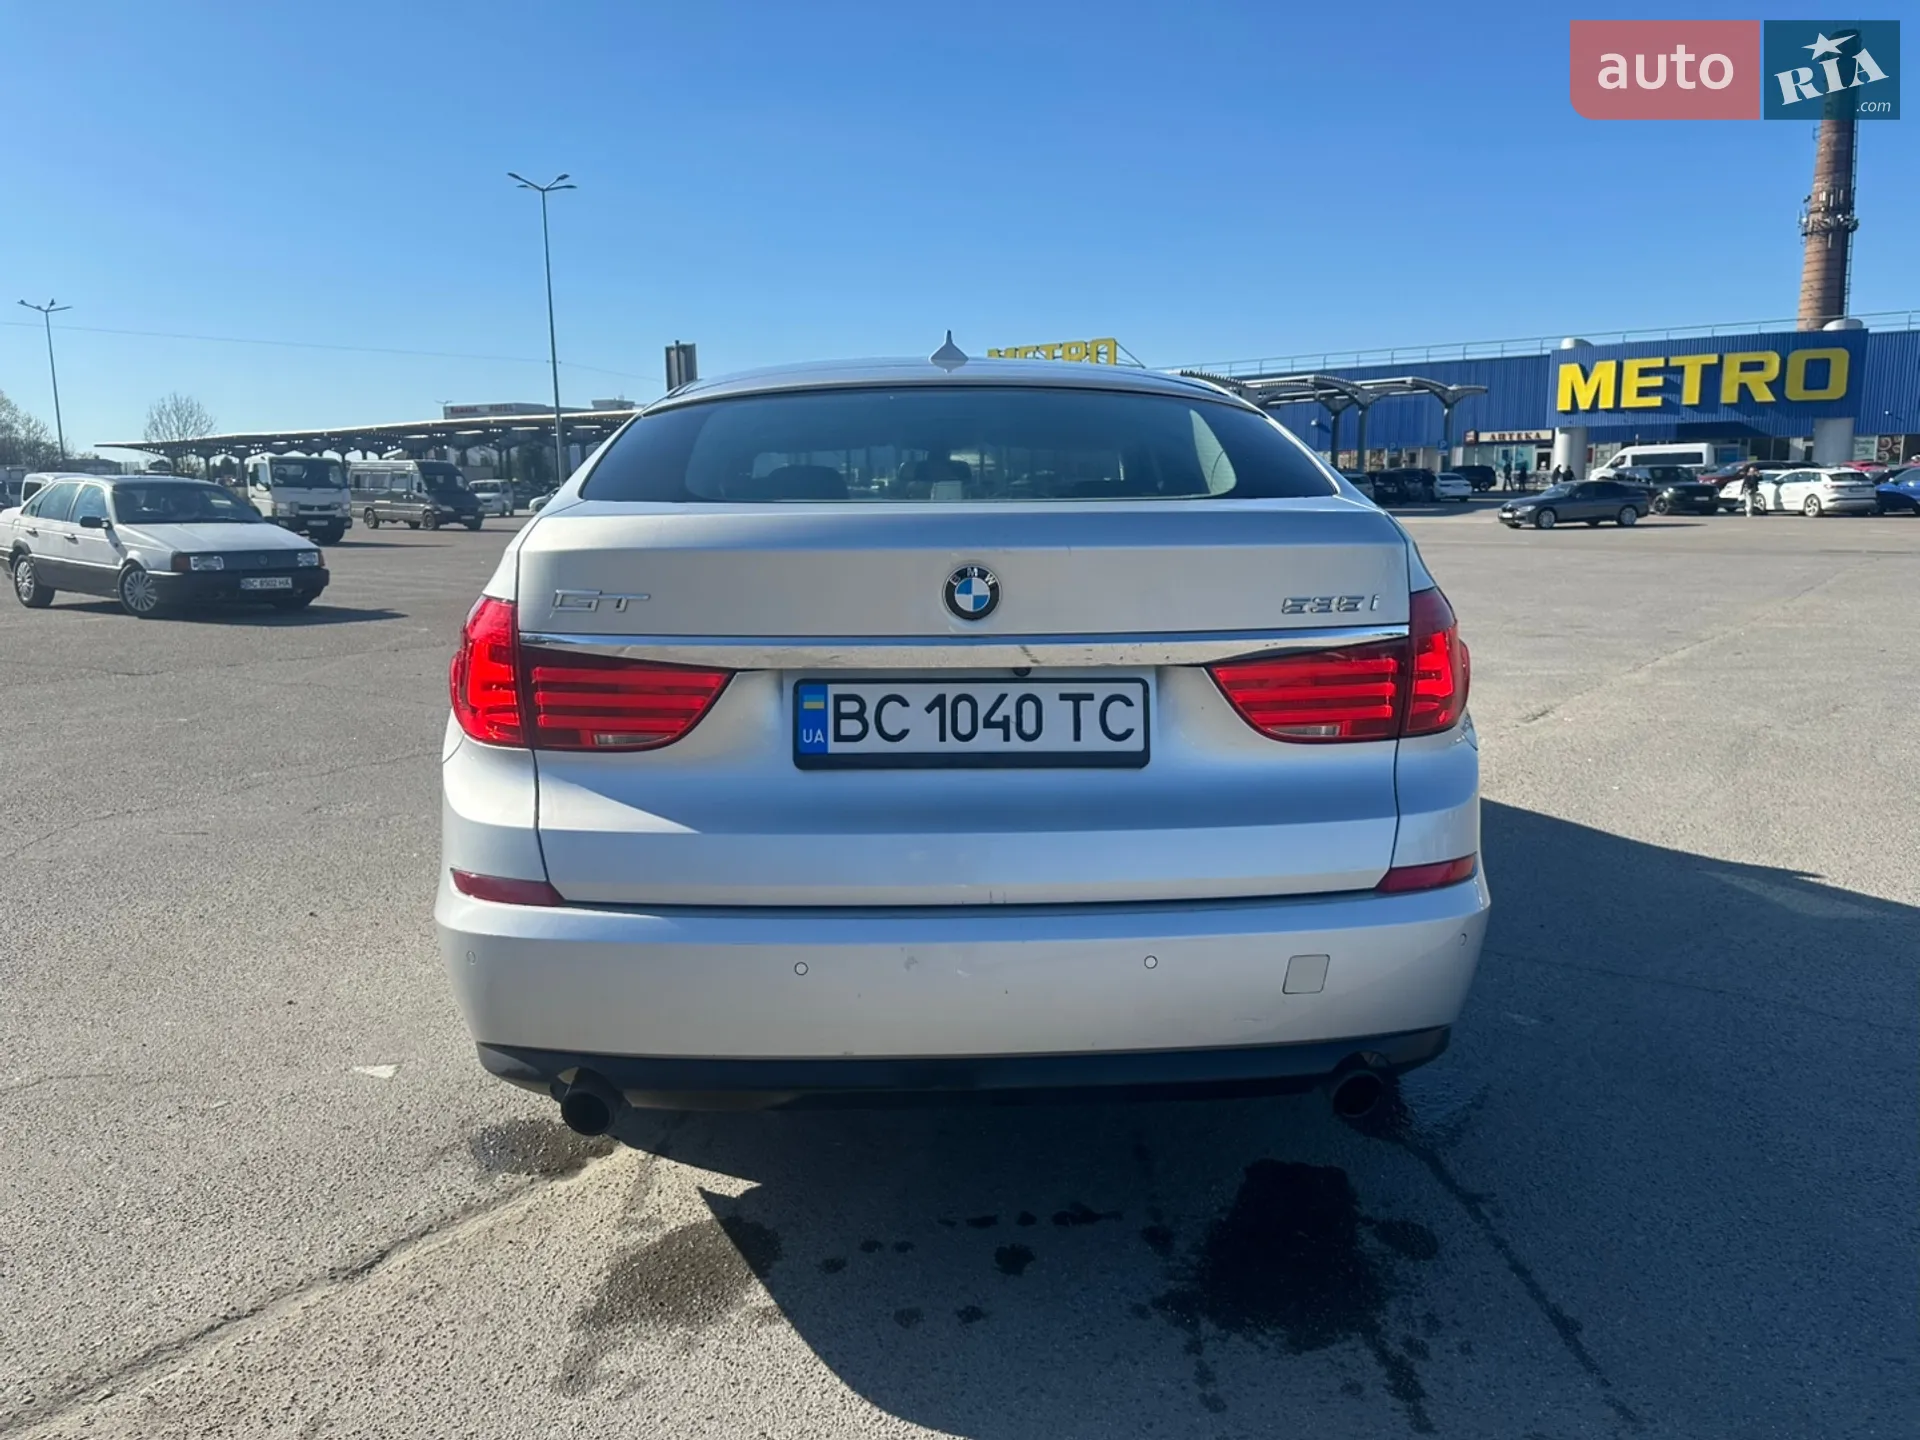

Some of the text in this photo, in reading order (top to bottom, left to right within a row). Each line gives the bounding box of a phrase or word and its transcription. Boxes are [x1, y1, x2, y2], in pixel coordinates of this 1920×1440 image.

[1556, 347, 1850, 411] METRO
[1490, 432, 1541, 441] АПТЕКА
[950, 567, 996, 586] BMW
[553, 589, 651, 613] GT
[1281, 594, 1380, 614] 535i
[832, 692, 1135, 743] BC 1040 TC
[803, 729, 825, 744] UA
